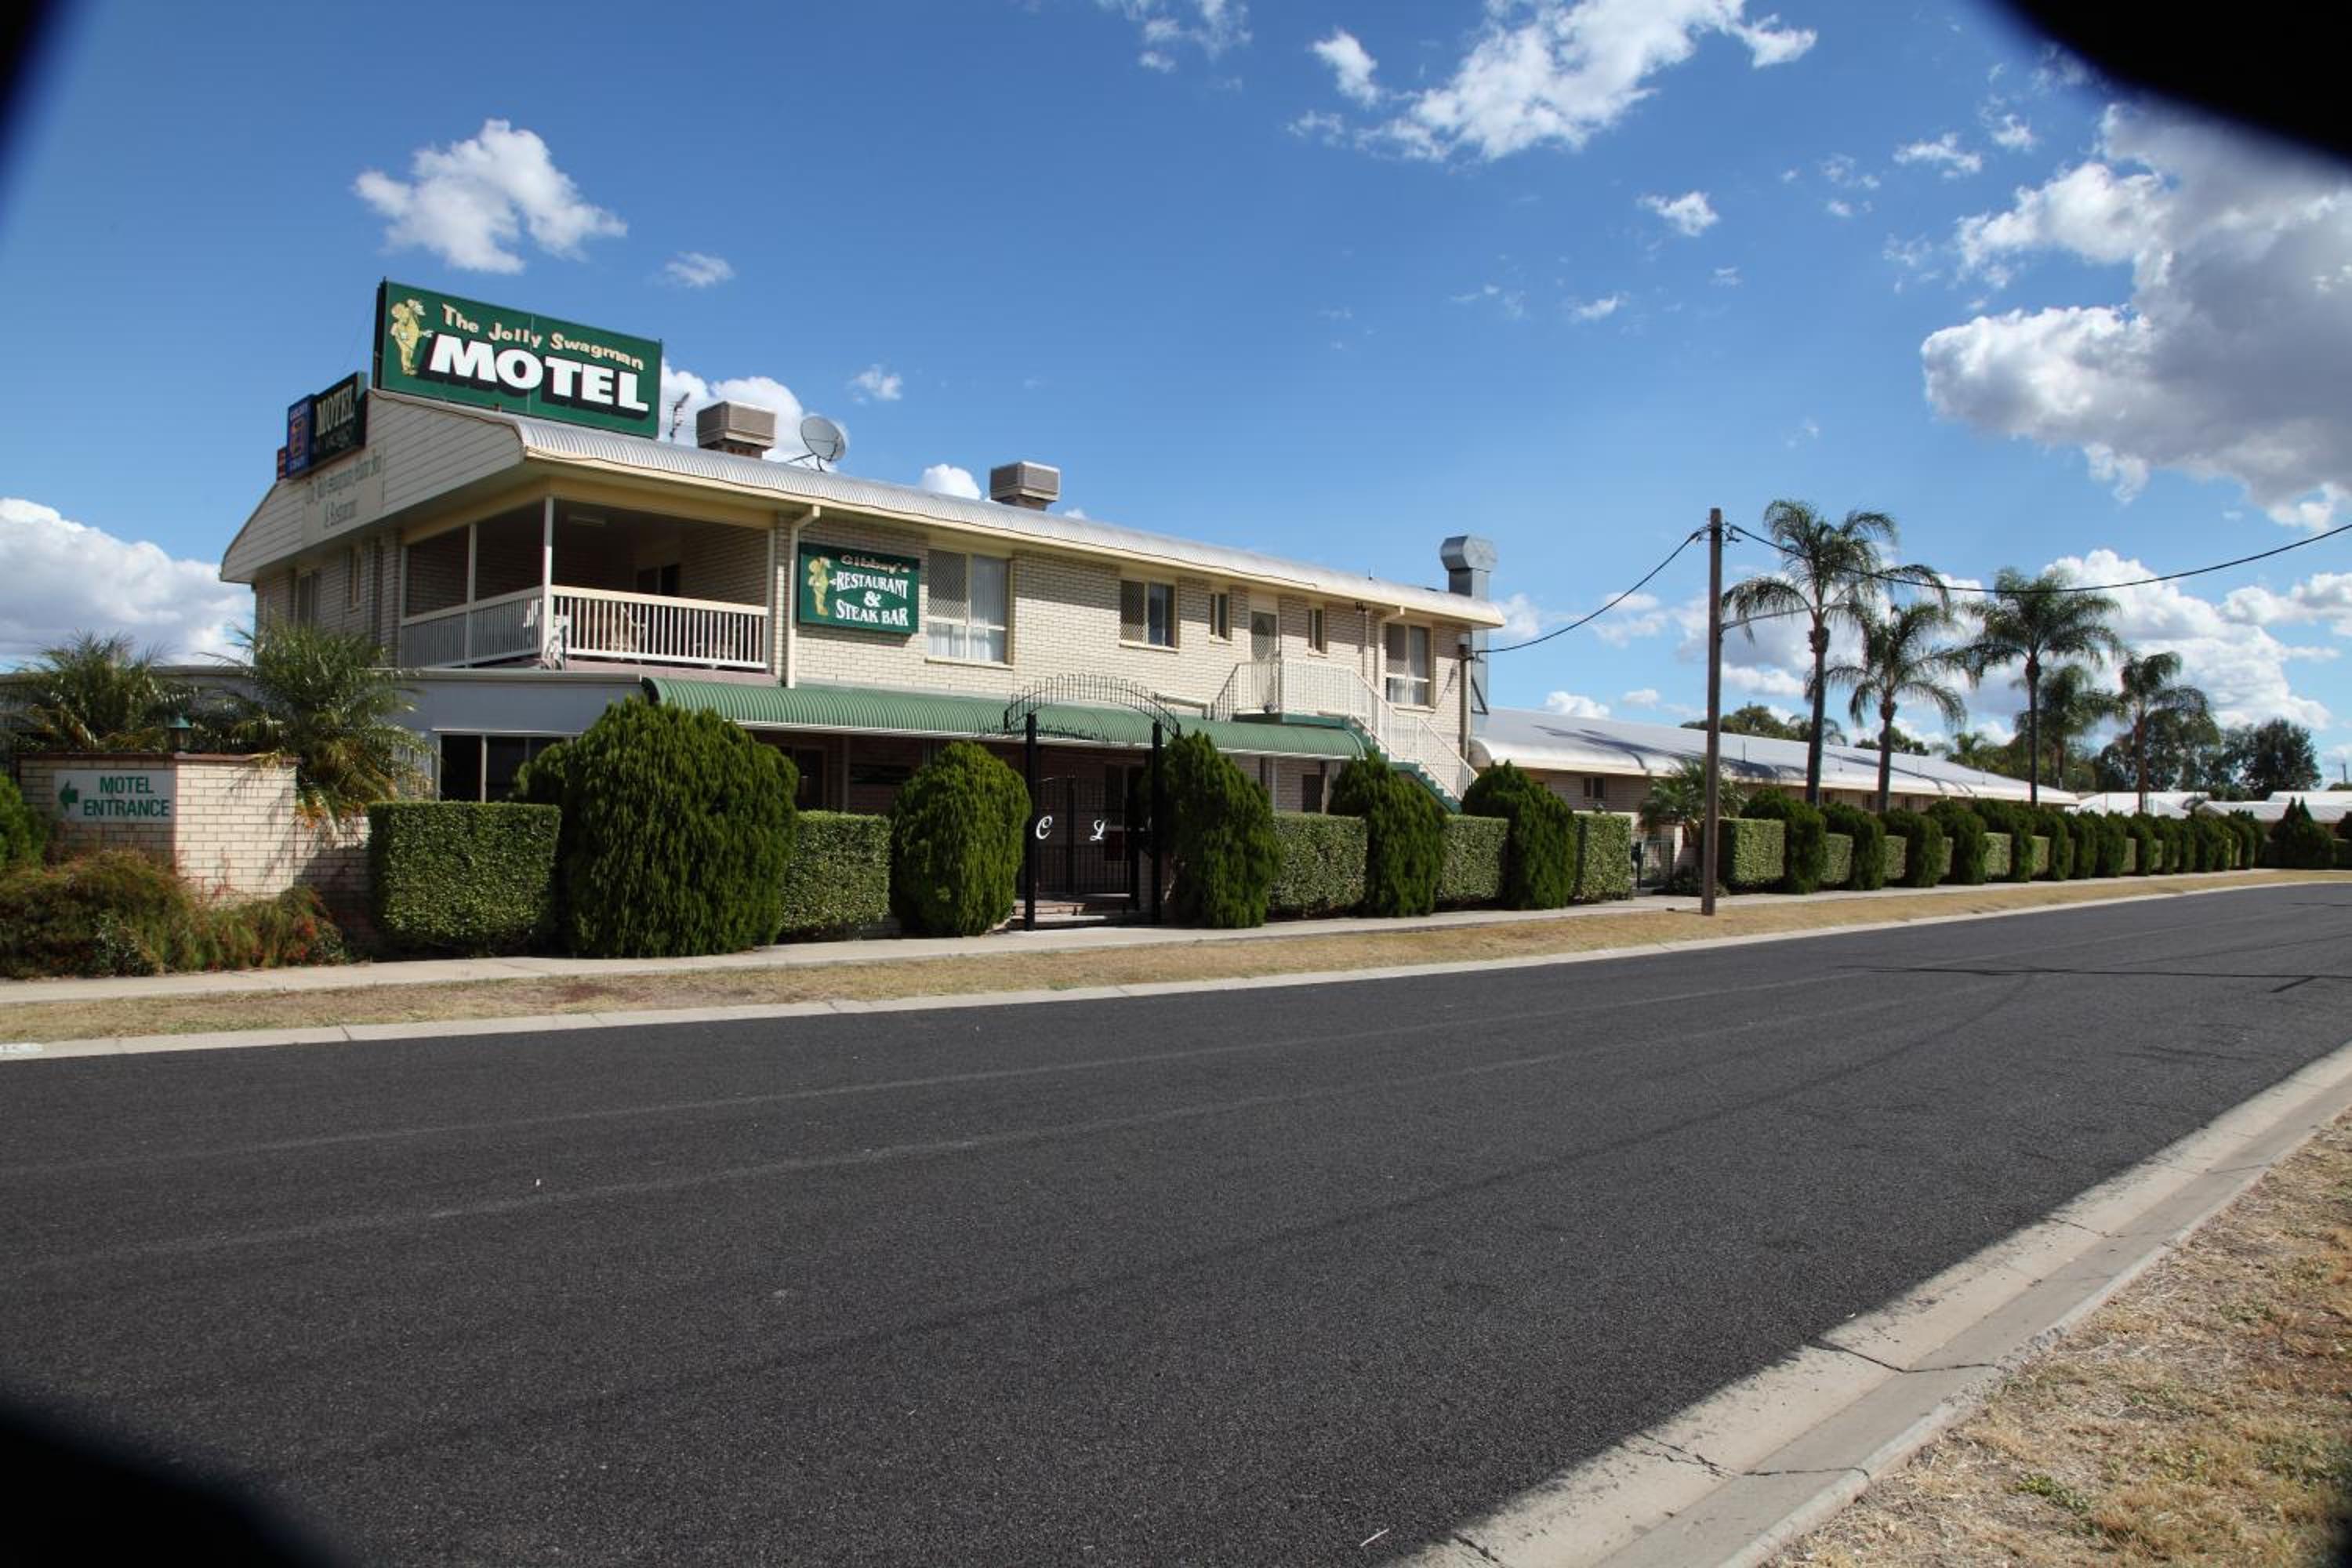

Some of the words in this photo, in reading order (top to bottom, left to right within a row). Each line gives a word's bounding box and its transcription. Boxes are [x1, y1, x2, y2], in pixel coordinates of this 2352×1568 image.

[442, 303, 479, 333] The
[488, 322, 543, 349] Jolly
[551, 332, 644, 371] Swagman
[430, 334, 648, 412] MOTEL
[837, 571, 909, 599] RESTAURANT
[836, 599, 878, 623] STEAK
[881, 608, 909, 626] BAR
[864, 590, 881, 608] &
[100, 776, 154, 794] MOTEL
[83, 799, 170, 816] ENTRANCE
